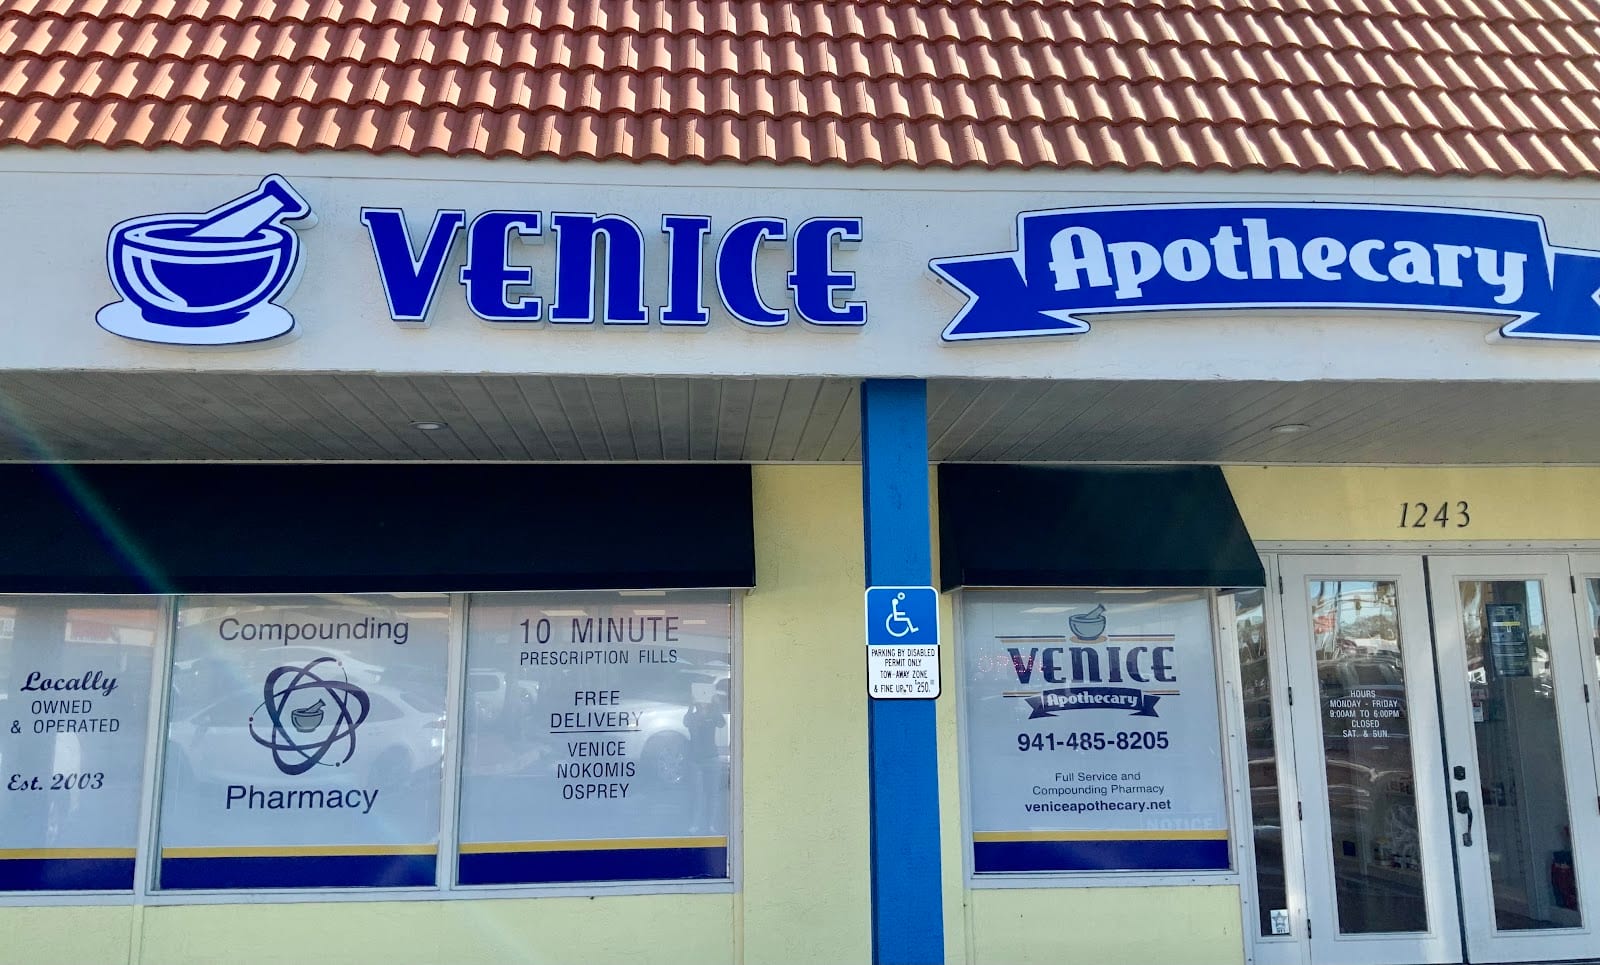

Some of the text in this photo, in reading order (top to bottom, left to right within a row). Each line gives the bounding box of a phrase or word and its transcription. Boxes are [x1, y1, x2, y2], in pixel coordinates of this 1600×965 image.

[361, 207, 867, 327] VENICE
[1049, 217, 1528, 304] Apothecary
[1398, 501, 1470, 528] 1243
[219, 617, 410, 645] Compounding
[520, 617, 680, 644] 10 MINUTE
[520, 649, 677, 666] PRESCRIPTION FILLS
[897, 648, 905, 657] BY
[884, 658, 922, 667] PERMIT ONLY
[1007, 646, 1177, 684] VENICE
[912, 670, 928, 679] ZONE
[20, 670, 119, 697] Locally
[873, 684, 879, 693] &
[880, 684, 894, 693] FINE
[574, 690, 621, 706] FREE
[1047, 690, 1139, 708] Apothecary
[1350, 689, 1376, 698] HOURS
[31, 700, 92, 715] OWNED
[1329, 699, 1361, 708] MONDAY
[1372, 699, 1398, 708] FRIDAY
[550, 711, 643, 728] DELIVERY
[1329, 709, 1400, 718] 9:00AM TO 6:00PM
[10, 718, 120, 734] & OPERATED
[1351, 719, 1380, 728] CLOSED
[1017, 731, 1169, 751] 941-485-8205
[1342, 729, 1359, 738] SAT.
[1362, 729, 1369, 738] &
[567, 741, 626, 757] VENICE
[557, 762, 636, 778] NOKOMIS
[1055, 771, 1141, 782] Full Service and
[8, 772, 105, 791] Est. 2003
[562, 783, 629, 800] OSPREY
[1032, 784, 1165, 797] Compounding Pharmacy
[226, 785, 379, 814] Pharmacy
[1025, 799, 1172, 813] veniceapothecary.net
